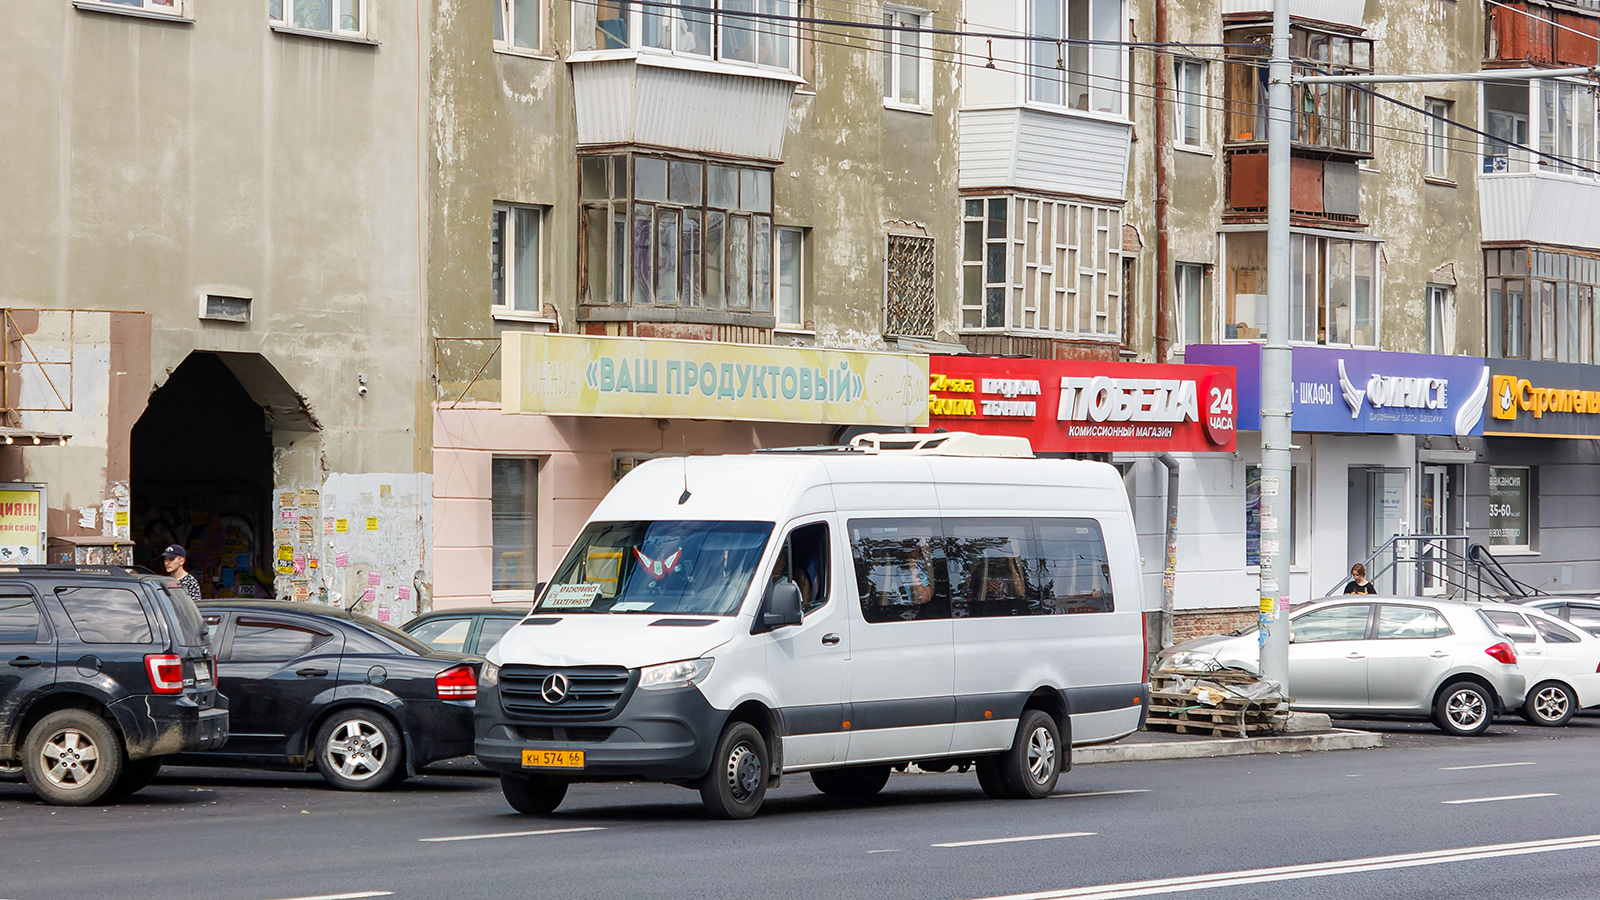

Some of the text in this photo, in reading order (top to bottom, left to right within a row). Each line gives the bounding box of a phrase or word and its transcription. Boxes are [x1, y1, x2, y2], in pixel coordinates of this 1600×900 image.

[586, 356, 864, 403] «ВАШ ПРОДУКТОВЫЙ»
[981, 378, 1041, 398] ПРОДАЖА
[1057, 376, 1199, 423] ПОБЕДА
[1210, 387, 1233, 414] 24
[1300, 382, 1334, 405] ШКАФЫ
[1367, 374, 1448, 409] ФИНИСТ
[981, 400, 1037, 417] ТЕХНИКИ
[1069, 425, 1173, 437] КОМИССИОННЫЙ МАГАЗИН
[1210, 417, 1234, 431] ЧАСА
[14, 523, 37, 532] сейф
[543, 752, 563, 765] 574
[569, 752, 580, 762] 66
